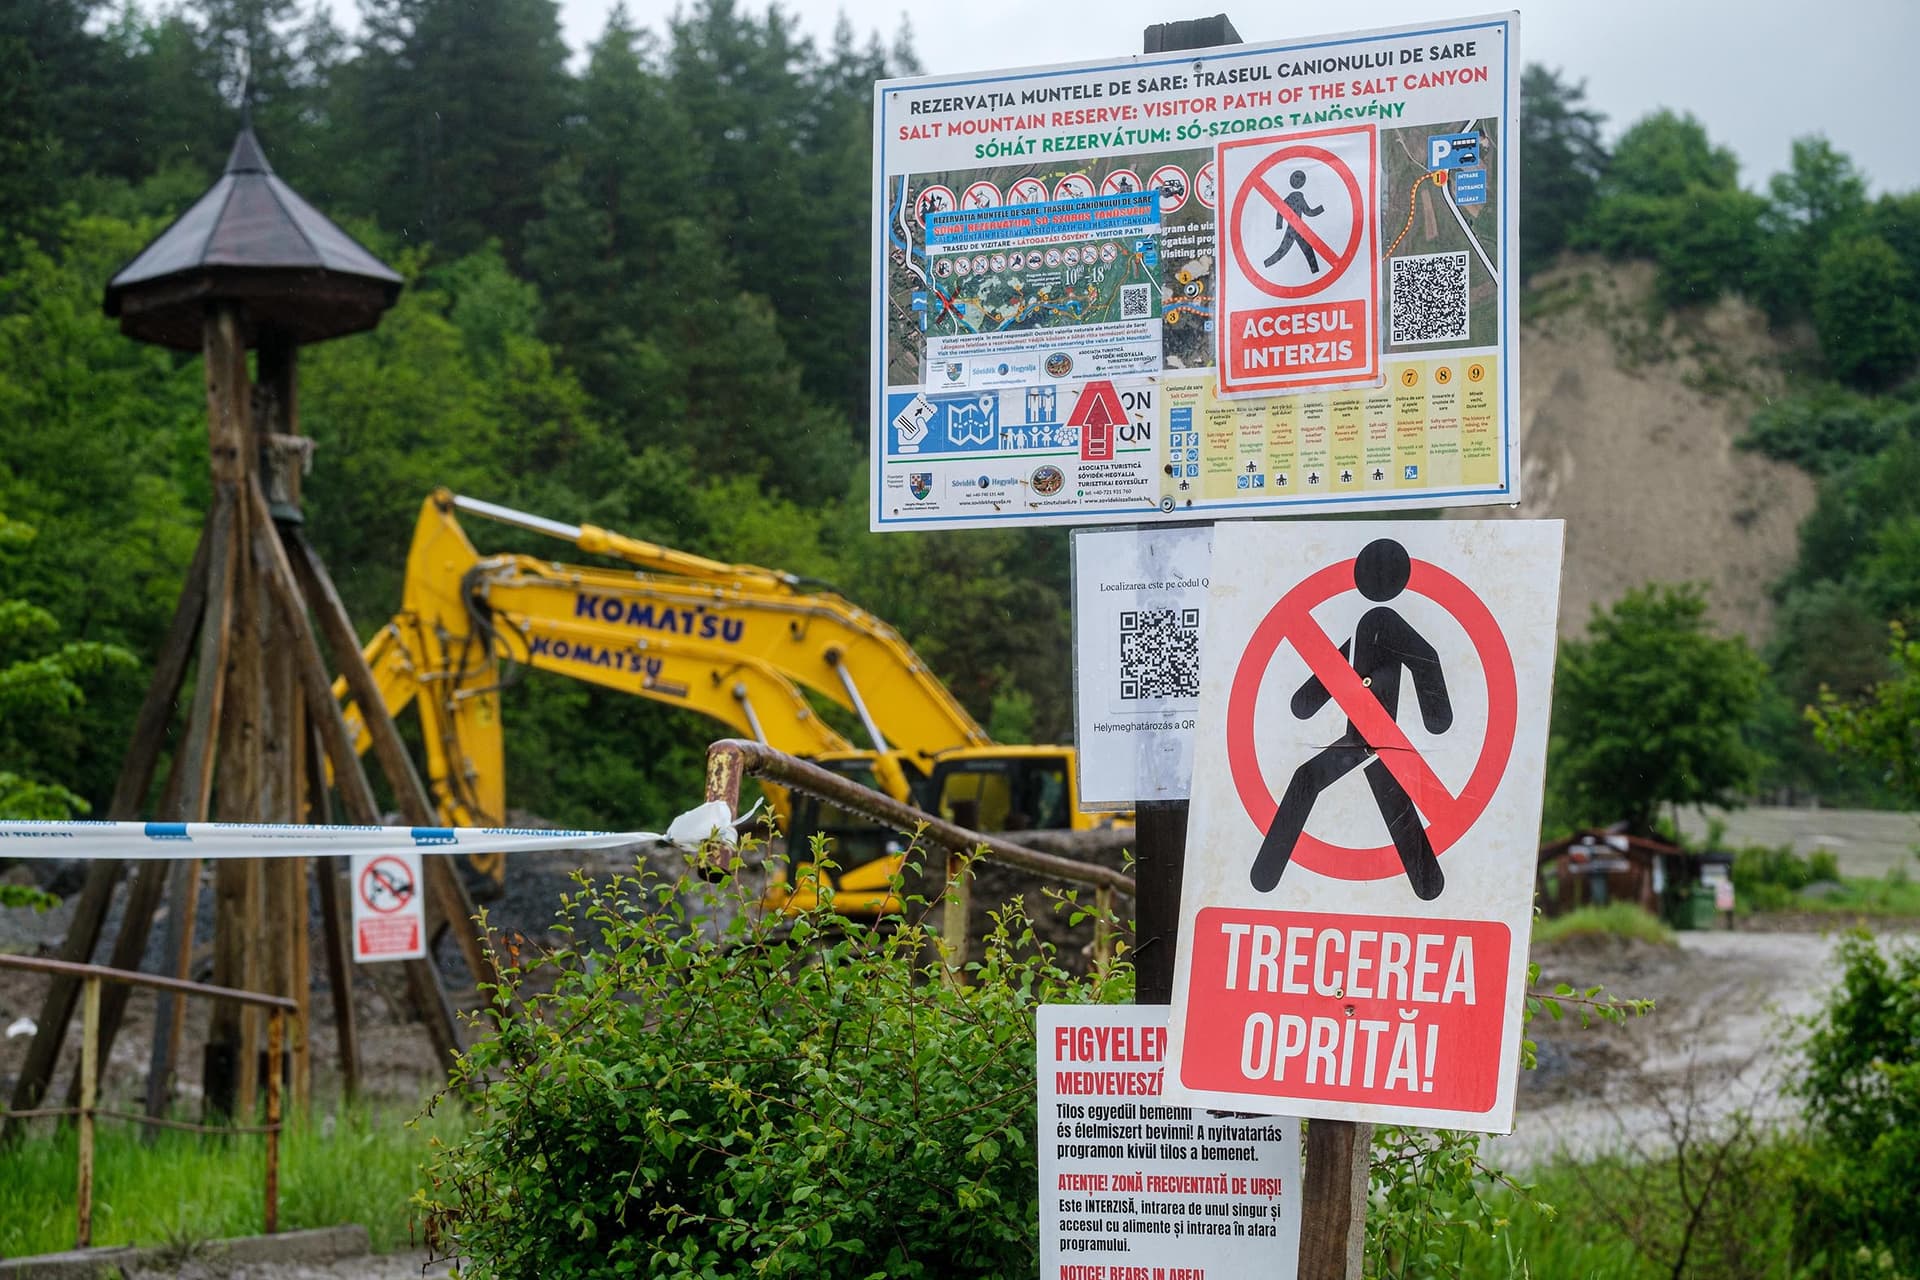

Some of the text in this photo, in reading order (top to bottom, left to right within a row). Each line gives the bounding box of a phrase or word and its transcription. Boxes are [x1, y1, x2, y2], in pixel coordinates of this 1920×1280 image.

[910, 41, 1477, 115] REZERVAȚIA MUNTELE DE SARE: TRASEUL CANIONULUI DE SARE
[899, 66, 1488, 140] SALT MOUNTAIN RESERVE: VISITOR PATH OF THE SALT CANYON
[975, 135, 1037, 159] SÓHÁT
[1042, 127, 1171, 153] REZERVÁTUM:
[1176, 115, 1284, 140] SÓ-SZOROS
[1432, 140, 1451, 167] P
[1457, 183, 1484, 191] ENTRANCE
[977, 210, 1009, 221] MUNTELE
[1011, 209, 1019, 218] DE
[1043, 203, 1074, 213] TRASEUL
[1076, 199, 1120, 211] CANIONULUI
[1122, 197, 1131, 206] DE
[1133, 195, 1152, 204] SARE
[1161, 225, 1186, 236] gram
[1187, 222, 1199, 232] de
[943, 243, 969, 252] TRASEU
[970, 241, 979, 249] DE
[981, 239, 1010, 248] VIZITARE
[1096, 229, 1123, 238] VISITOR
[1125, 227, 1143, 235] PATH
[1161, 248, 1195, 258] Visiting
[1242, 309, 1353, 339] ACCESUL
[1244, 340, 1353, 369] INTERZIS
[1406, 373, 1413, 383] 7
[1440, 371, 1447, 380] 8
[1473, 368, 1480, 377] 9
[1116, 422, 1151, 441] ON
[1173, 436, 1180, 446] P
[1100, 580, 1146, 592] Localizarea
[1148, 582, 1163, 590] este
[1165, 582, 1176, 592] pe
[1177, 578, 1200, 589] codul
[575, 594, 744, 643] KOMATSU
[532, 636, 663, 676] KOMATSU
[1094, 722, 1173, 733] Helymeghatározás
[1182, 720, 1195, 730] QR
[1220, 922, 1477, 1005] TRECEREA
[1240, 1008, 1439, 1093] OPRITĂ!
[1056, 1103, 1192, 1122] Tilos egyedül bemenni
[1057, 1123, 1282, 1143] és élelmiszert bevinni! A nyitvatartás
[1057, 1144, 1124, 1161] programon
[1160, 1144, 1187, 1160] tilos
[1190, 1147, 1198, 1160] a
[1201, 1146, 1259, 1161] bemenet.
[1058, 1171, 1282, 1201] ATENȚIE! ZONĂ FRECVENTATĂ DE URȘI!
[1059, 1197, 1281, 1222] Este INTERZISĂ, intrarea de unul singur și
[1060, 1217, 1276, 1238] accesul cu alimente și intrarea în afara
[1060, 1238, 1130, 1253] programului.
[1060, 1264, 1205, 1280] NOTICE! BEARS IN AREA!
